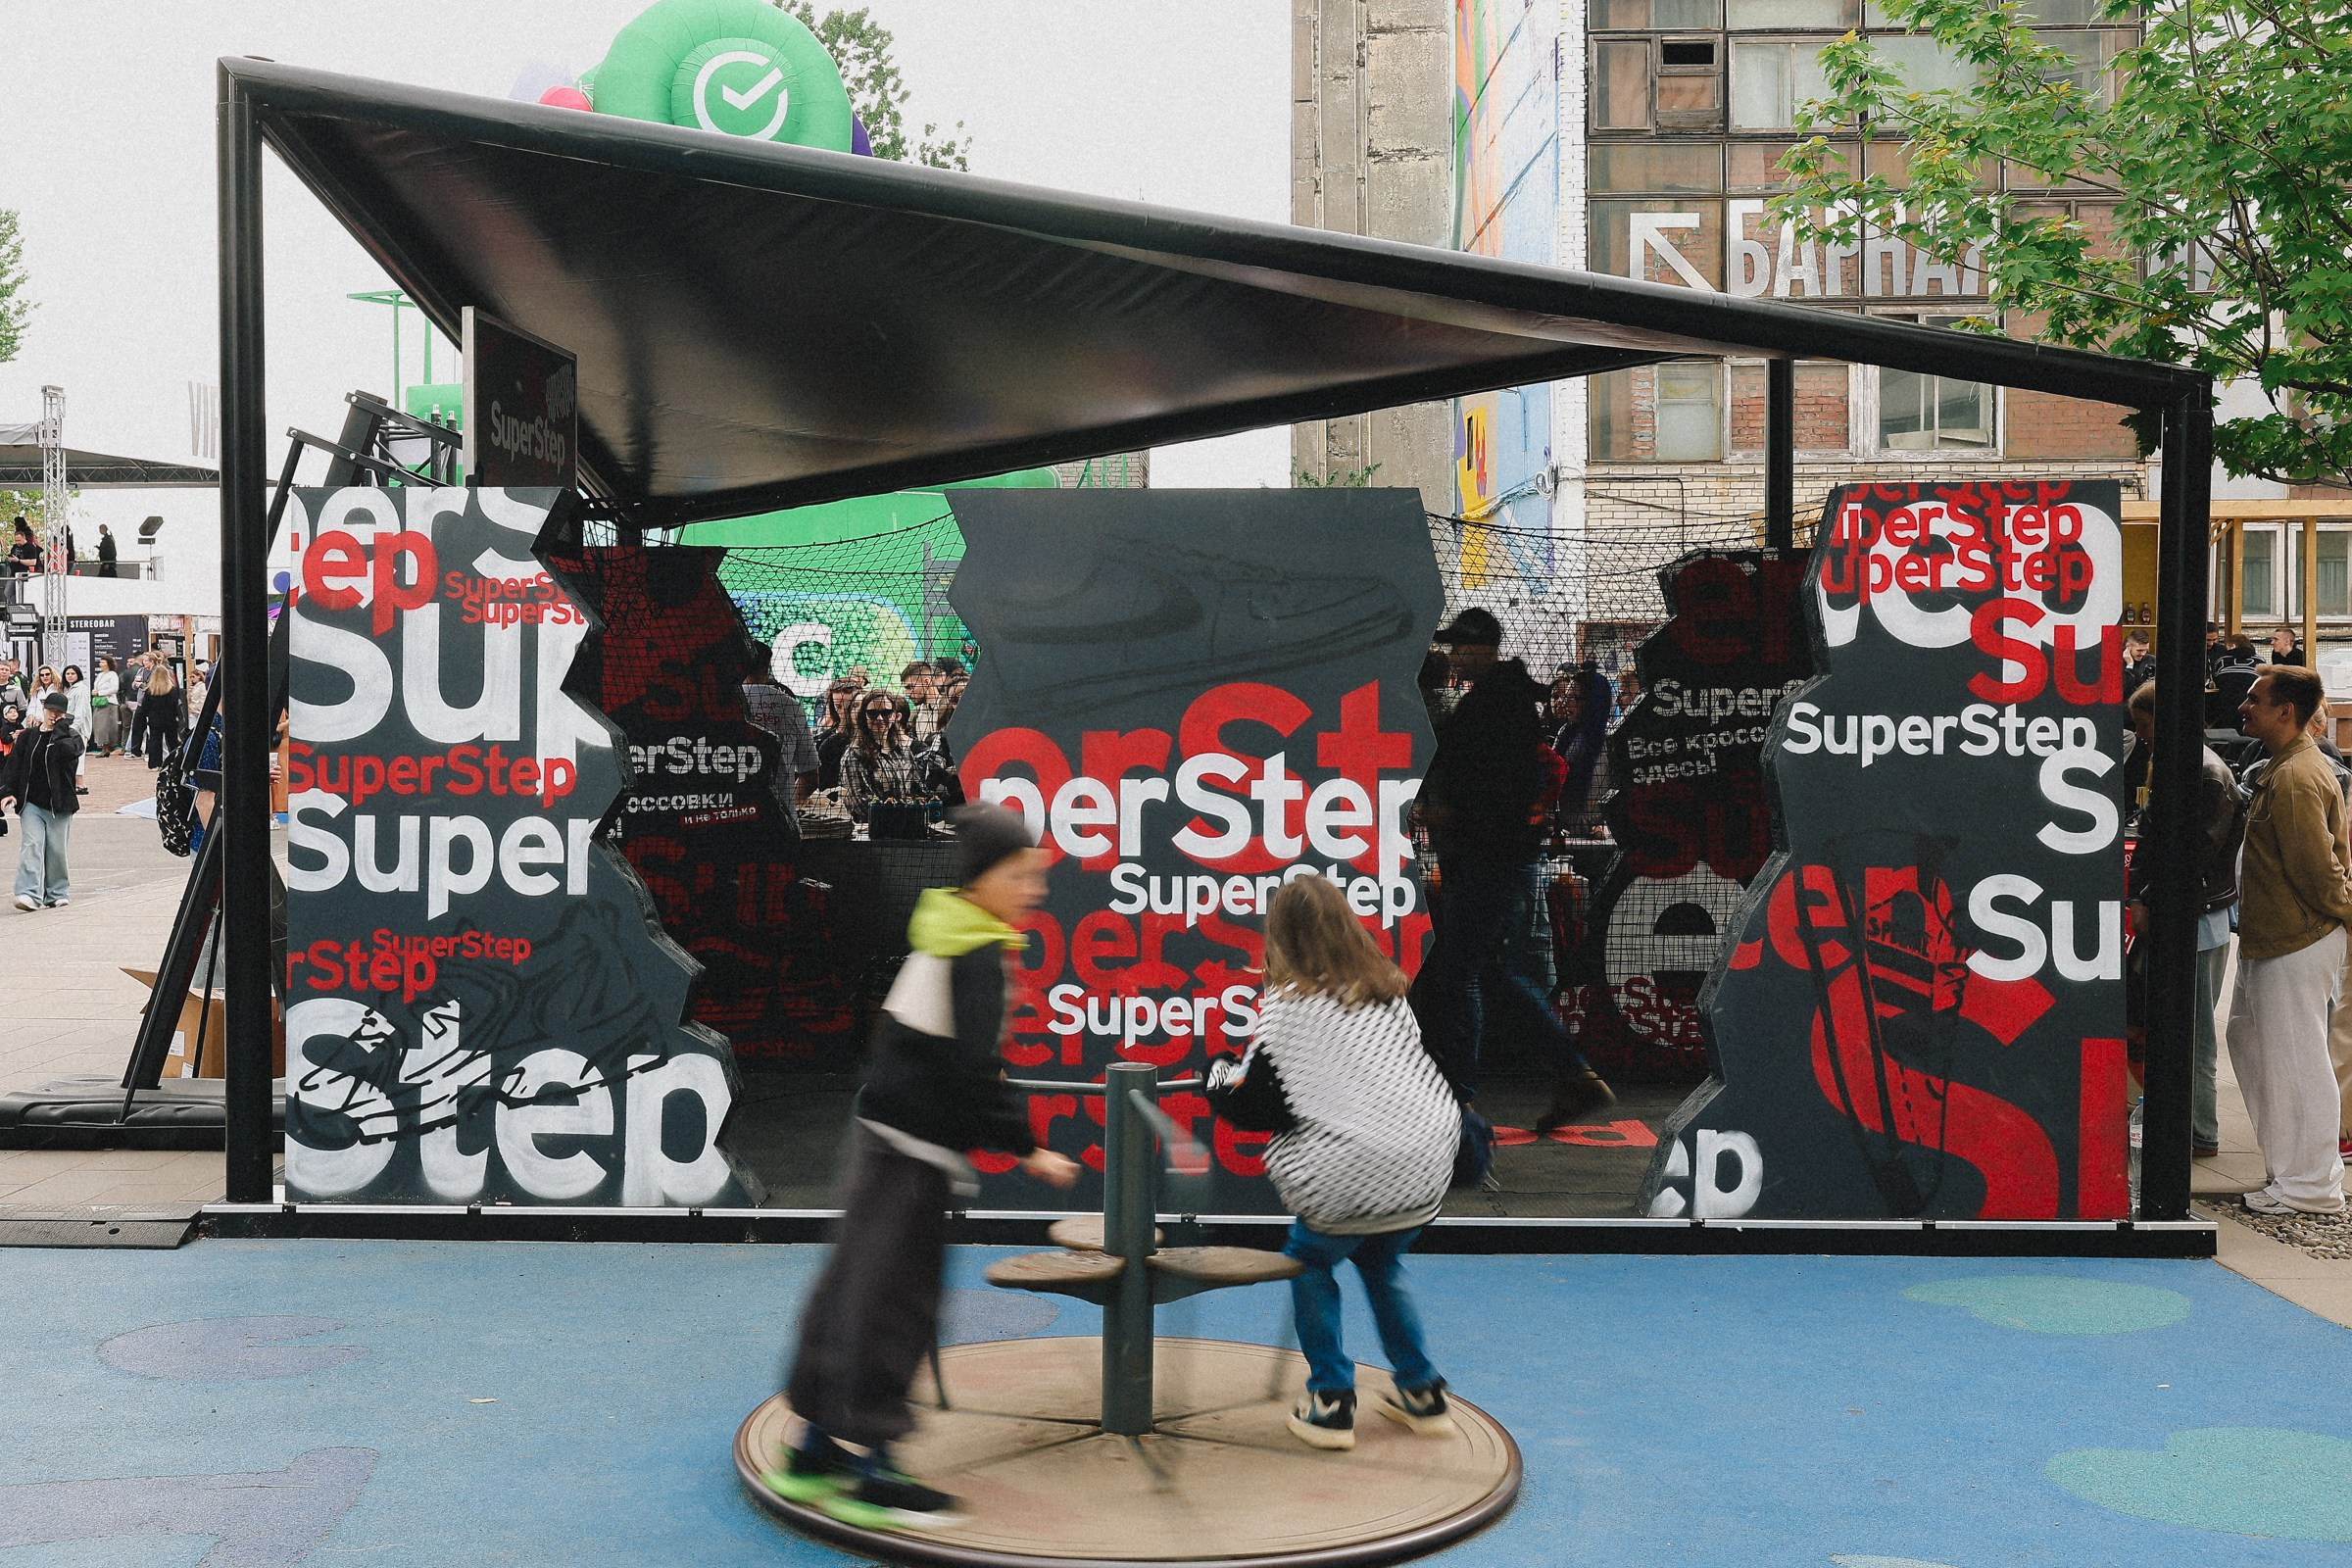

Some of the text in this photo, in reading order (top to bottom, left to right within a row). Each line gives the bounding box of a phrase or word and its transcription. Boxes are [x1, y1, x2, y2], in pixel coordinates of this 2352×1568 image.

[491, 400, 565, 475] SuperStep
[290, 530, 438, 636] ep
[445, 571, 567, 603] SuperS
[1821, 501, 2123, 650] ep
[70, 619, 115, 628] STEREOBAR
[462, 595, 584, 630] SuperSt
[1967, 598, 2124, 705] Su
[1627, 726, 1771, 760] Все кросс
[1782, 702, 2097, 768] SuperStep
[289, 744, 576, 808] SuperStep
[1632, 752, 1717, 785] здесь!
[624, 793, 733, 813] оссовки
[288, 787, 601, 920] Super
[372, 928, 531, 966] SuperStep
[1964, 873, 2121, 982] Su
[1047, 984, 1267, 1050] SuperS
[285, 998, 731, 1206] Step
